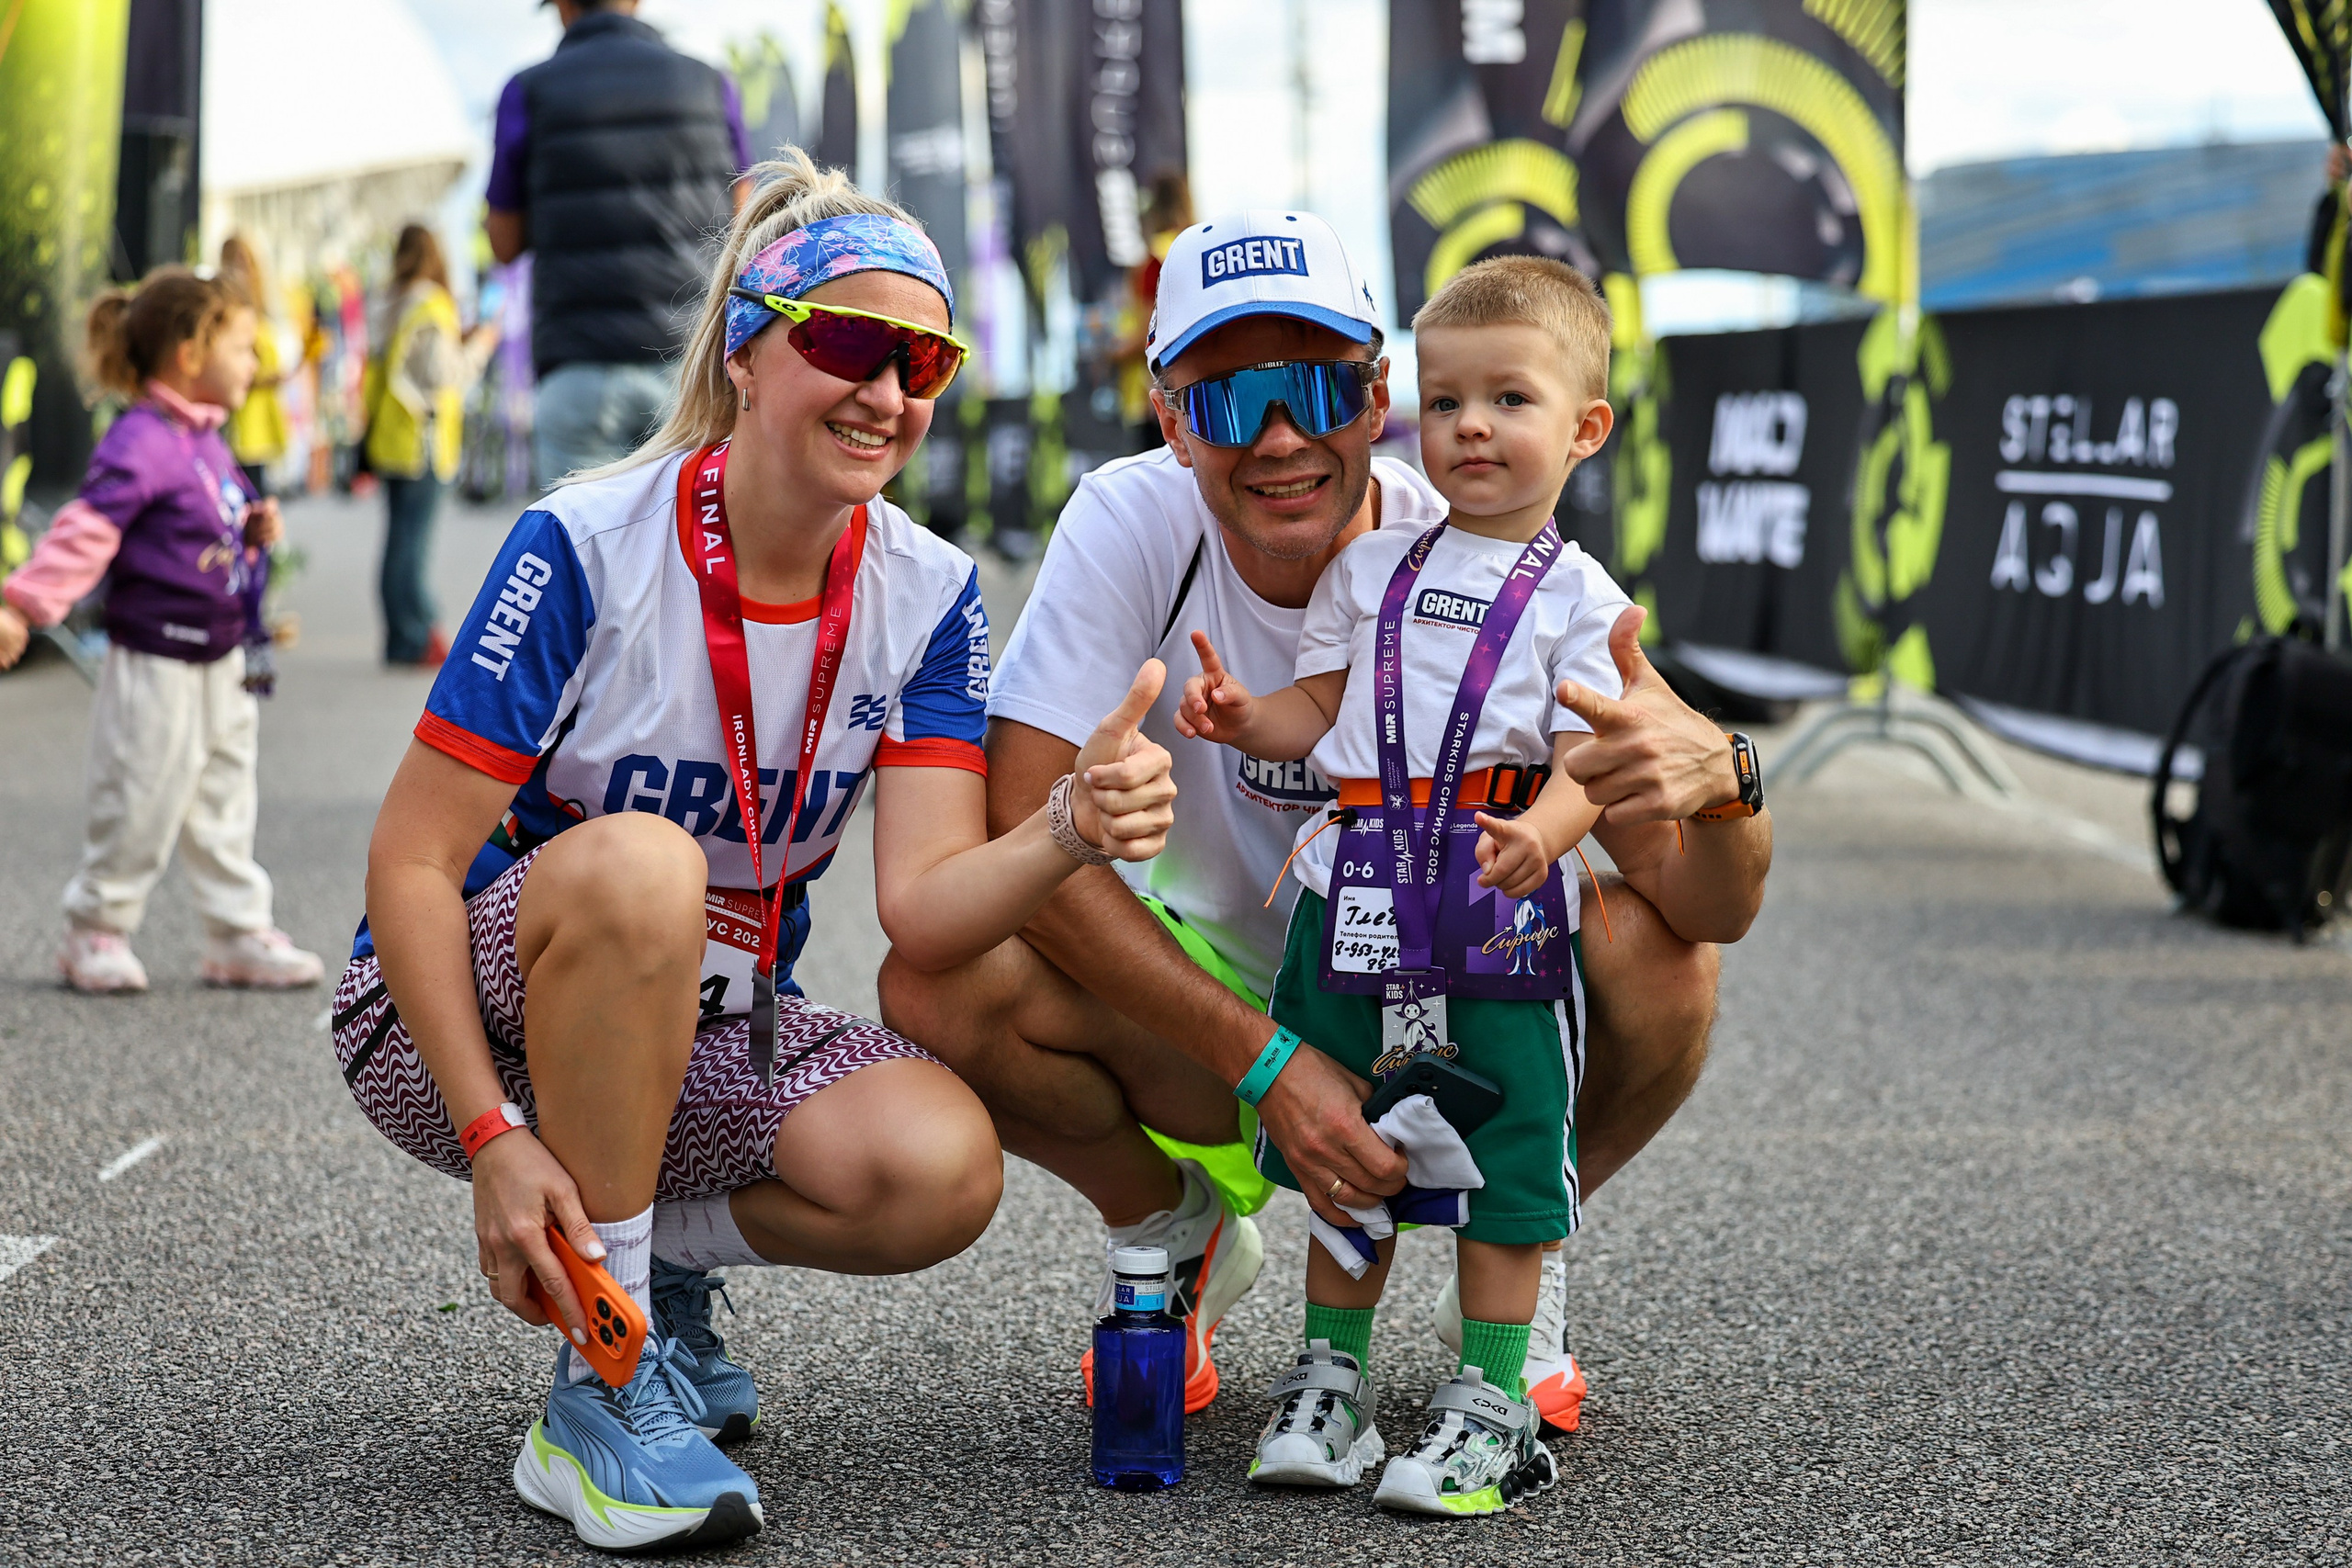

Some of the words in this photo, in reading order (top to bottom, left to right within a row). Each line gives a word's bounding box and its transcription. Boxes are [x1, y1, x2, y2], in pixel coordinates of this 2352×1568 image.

[1208, 240, 1300, 278] GRENT
[700, 467, 726, 575] FINAL
[1510, 519, 1559, 580] INAL
[471, 552, 552, 682] GRENT
[1413, 618, 1455, 629] АРХИТЕКТОР
[1457, 626, 1480, 635] ЧИСТО
[1421, 592, 1490, 624] GRENT
[962, 595, 990, 702] GRENT
[1384, 621, 1396, 709] SUPREME
[805, 718, 819, 753] MIR
[812, 606, 842, 713] SUPREME
[1385, 714, 1396, 744] MIR
[1444, 712, 1469, 783] STARKIDS
[732, 714, 752, 801] IRONLADY
[1243, 753, 1329, 791] GREN
[603, 754, 871, 844] GRENT
[1236, 782, 1299, 812] АРХИТЕКТОР
[1303, 807, 1323, 815] ЧИ
[1430, 786, 1451, 845] СИРИУС
[1369, 818, 1384, 829] KIDS
[1393, 829, 1405, 851] KIDS
[1342, 861, 1374, 878] 0-6
[1396, 861, 1408, 884] STAR
[1426, 849, 1439, 885] 2026
[706, 893, 725, 906] MIR
[727, 899, 760, 919] SUPRE
[707, 918, 729, 935] УС
[733, 928, 760, 947] 202
[1385, 991, 1403, 999] KIDS
